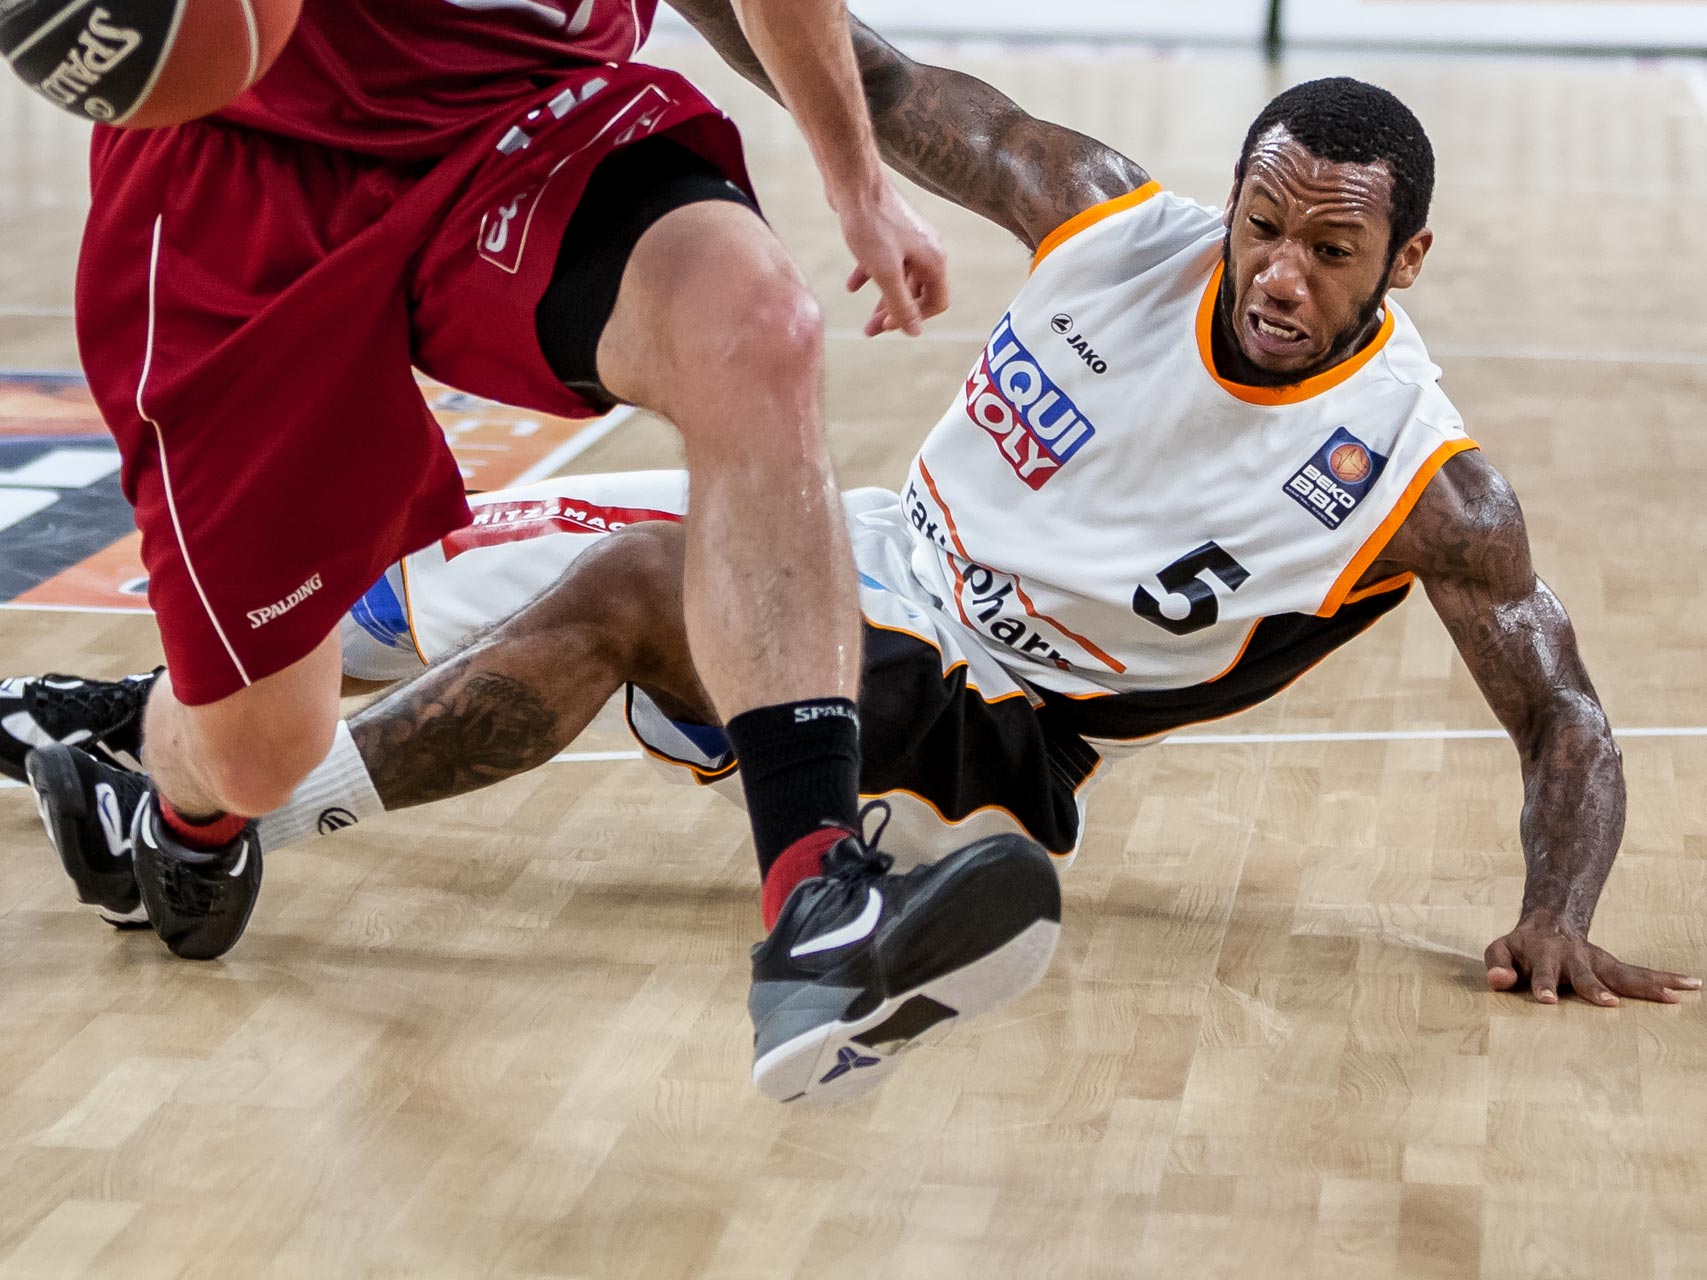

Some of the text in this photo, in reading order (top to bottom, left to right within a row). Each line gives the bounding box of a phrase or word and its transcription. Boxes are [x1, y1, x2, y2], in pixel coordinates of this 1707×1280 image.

[1066, 333, 1108, 375] JAKO
[967, 348, 1060, 479] MOLY
[987, 318, 1090, 457] LIQUI
[1289, 474, 1341, 524] BBL
[1302, 463, 1356, 510] BEKO
[245, 571, 323, 630] SPALDING
[1132, 539, 1252, 637] 5
